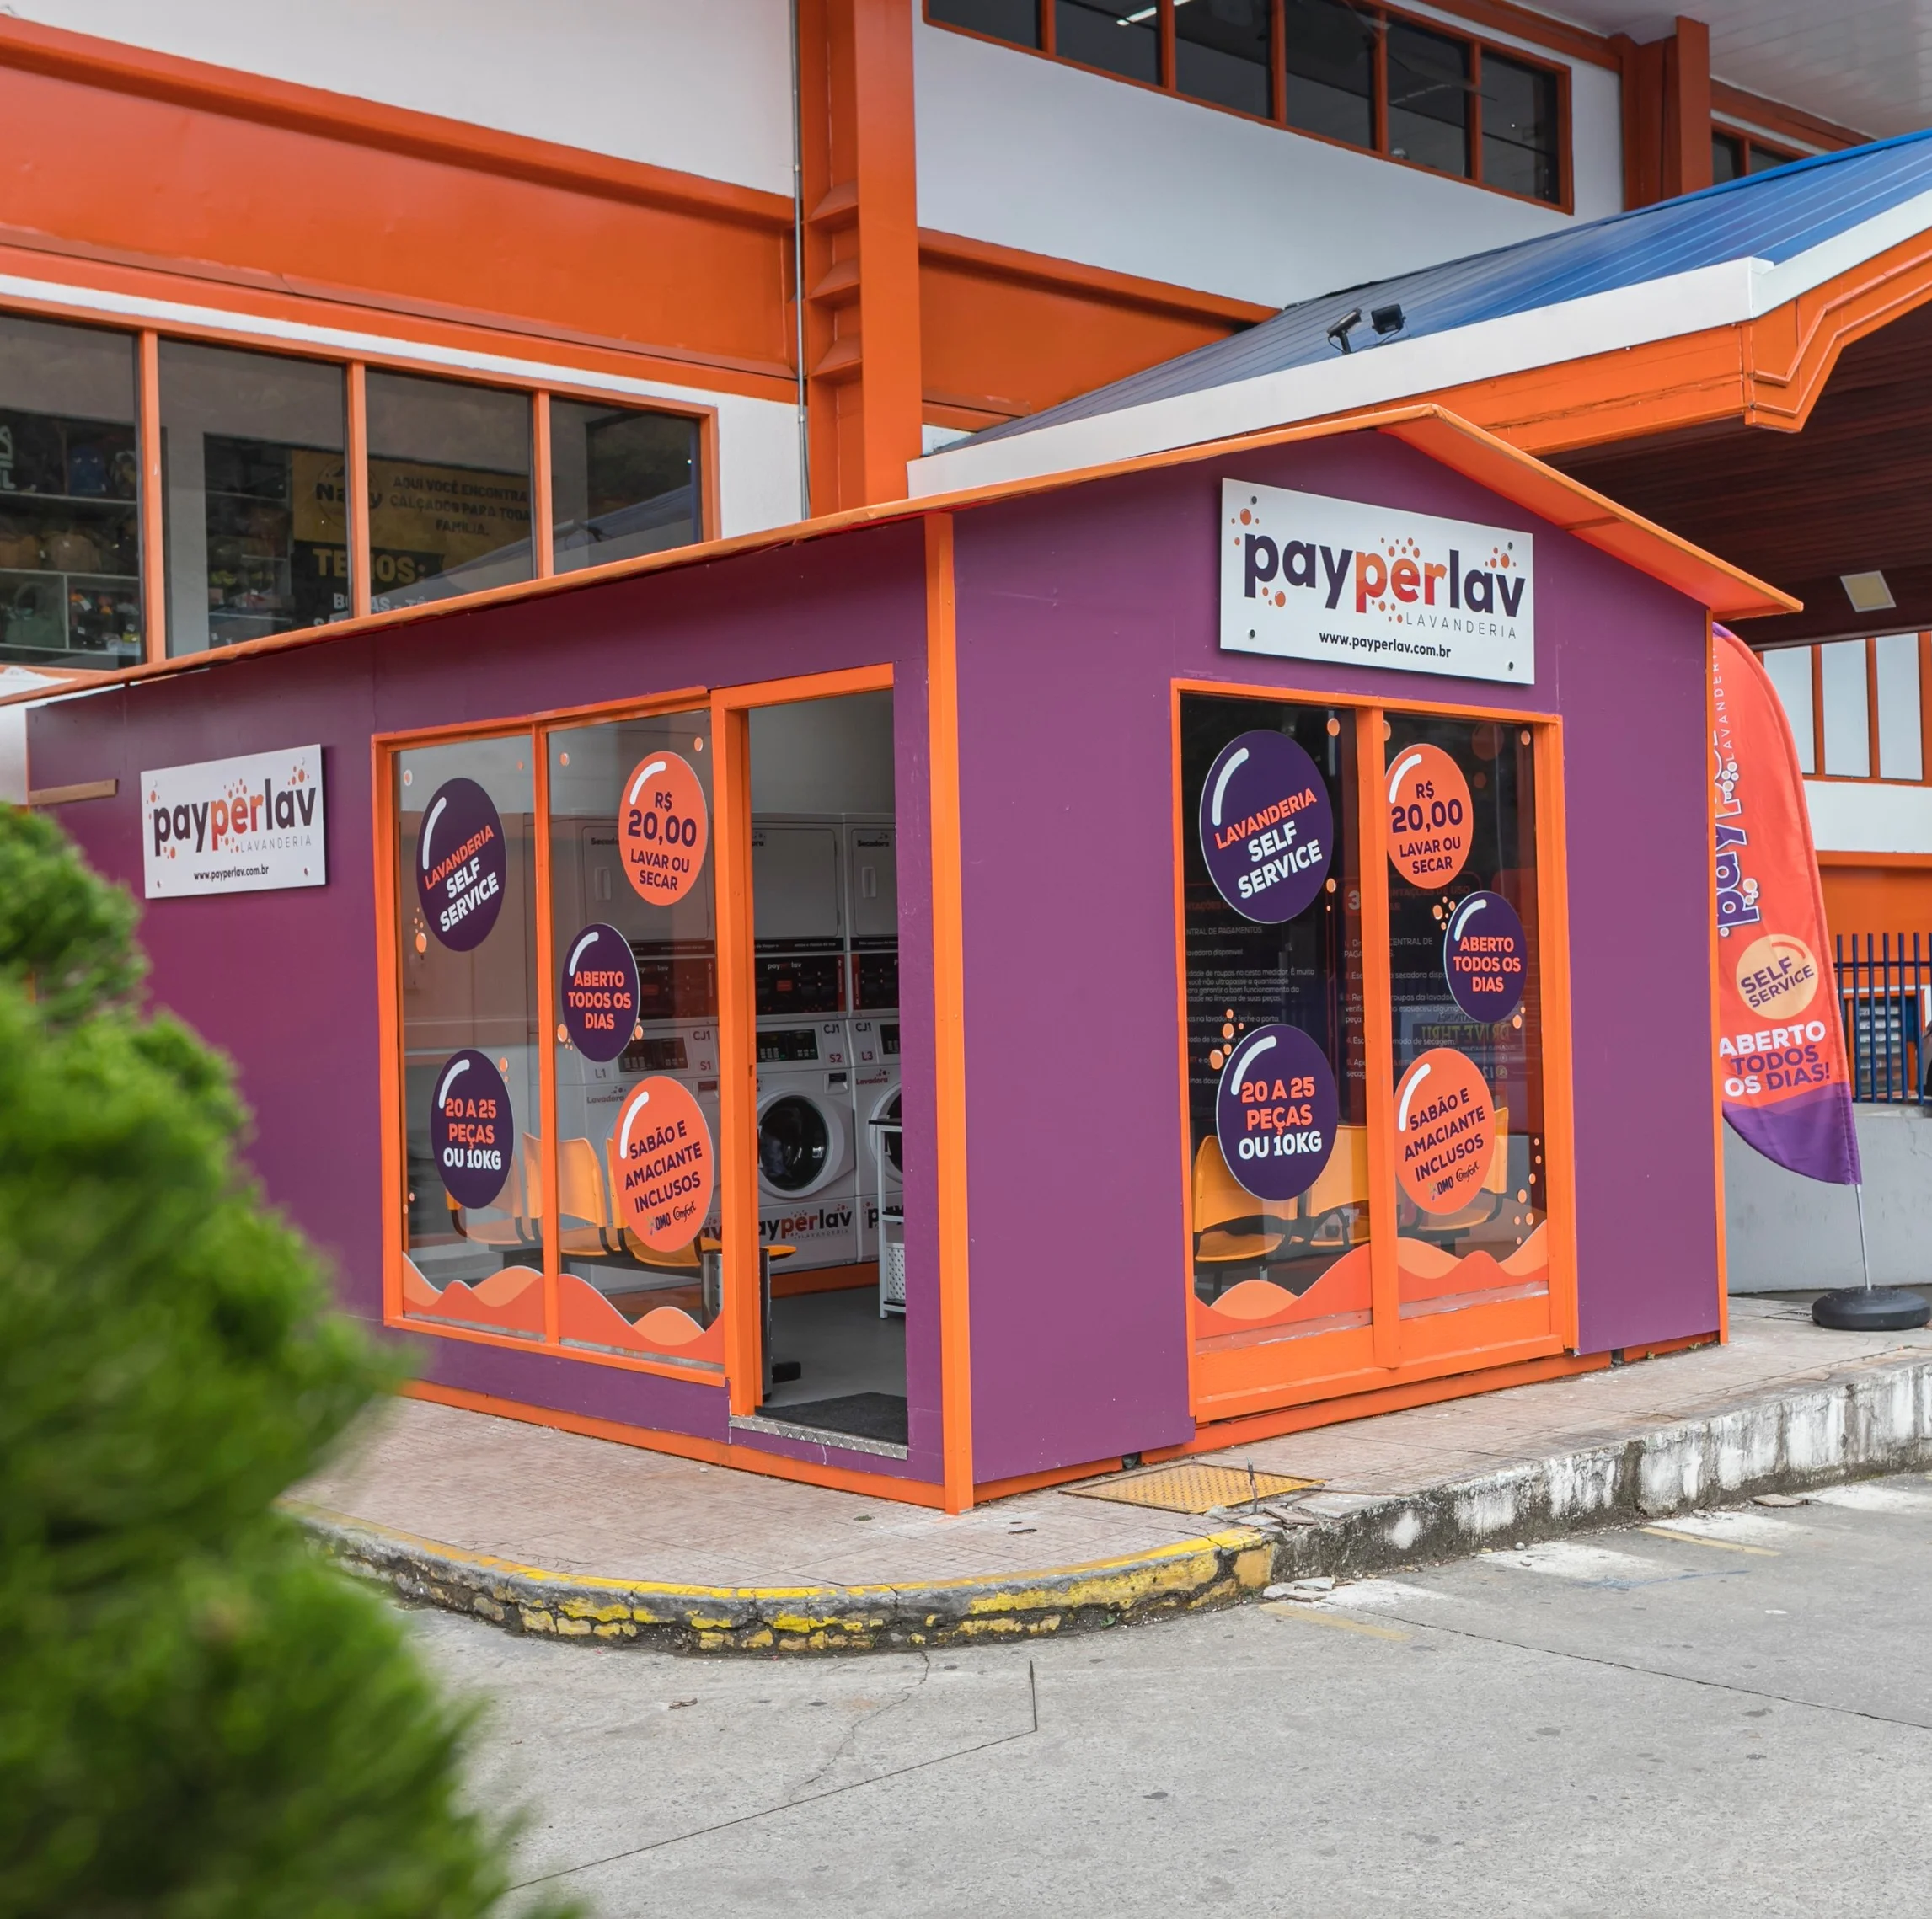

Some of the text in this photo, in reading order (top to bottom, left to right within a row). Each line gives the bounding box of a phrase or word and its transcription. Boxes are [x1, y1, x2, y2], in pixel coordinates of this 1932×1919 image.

[393, 476, 424, 489] AQUI
[461, 484, 527, 502] ENCONTRA
[313, 548, 425, 584] TEOS:
[1244, 532, 1526, 617] payperlav
[1405, 611, 1517, 639] LAVANDERIA
[1319, 631, 1452, 659] www.payperlav.com.br
[654, 791, 673, 812] R$
[1416, 780, 1435, 800] R$
[153, 778, 317, 858] payperlav
[627, 809, 698, 848] 20,00
[1214, 787, 1318, 849] LAVANDERIA
[1390, 798, 1464, 834] 20,00
[240, 834, 312, 853] LAVANDERIA
[1247, 820, 1298, 863] SELF
[1399, 835, 1462, 858] LAVAR OU
[425, 824, 495, 890] LAVANDERIA
[630, 848, 690, 874] LAVAR OU
[1237, 839, 1324, 900] SERVICE
[1411, 855, 1454, 875] SECAR
[193, 863, 270, 882] www.payperlav.com.br
[446, 857, 481, 899] SELF
[639, 869, 678, 891] SECAR
[439, 871, 500, 933] SERVICE
[1459, 936, 1515, 953] ABERTO
[1453, 956, 1522, 973] TODOS OS
[1740, 955, 1793, 995] SELF
[573, 970, 626, 988] ABERTO
[1471, 976, 1505, 992] DIAS
[1747, 965, 1815, 1008] SERVICE
[568, 991, 632, 1010] TODOS OS
[585, 1012, 615, 1030] DIAS
[823, 1024, 840, 1034] CJ1
[855, 1022, 871, 1033] CJ1
[693, 1030, 711, 1041] CJ1
[1720, 1020, 1826, 1058] ABERTO
[699, 1061, 712, 1071] S1
[828, 1053, 842, 1064] S2
[861, 1050, 873, 1061] L3
[1730, 1045, 1819, 1076] TODOS
[595, 1067, 607, 1079] L1
[1724, 1061, 1831, 1097] OS DIAS!
[1240, 1076, 1316, 1104] 20 A 25
[444, 1098, 497, 1120] 20 A 25
[1245, 1104, 1314, 1136] PEÇAS
[1409, 1087, 1470, 1131] SABÃO E
[448, 1123, 495, 1151] PEÇAS
[629, 1120, 688, 1161] SABÃO E
[1238, 1130, 1323, 1160] OU 10KG
[1404, 1105, 1486, 1162] AMACIANTE
[442, 1147, 502, 1171] OU 10KG
[624, 1141, 704, 1191] AMACIANTE
[1414, 1132, 1485, 1183] INCLUSOS
[634, 1170, 702, 1214] INCLUSOS
[1436, 1161, 1480, 1196] OMO Comfort
[655, 1200, 697, 1232] OMO Comfort
